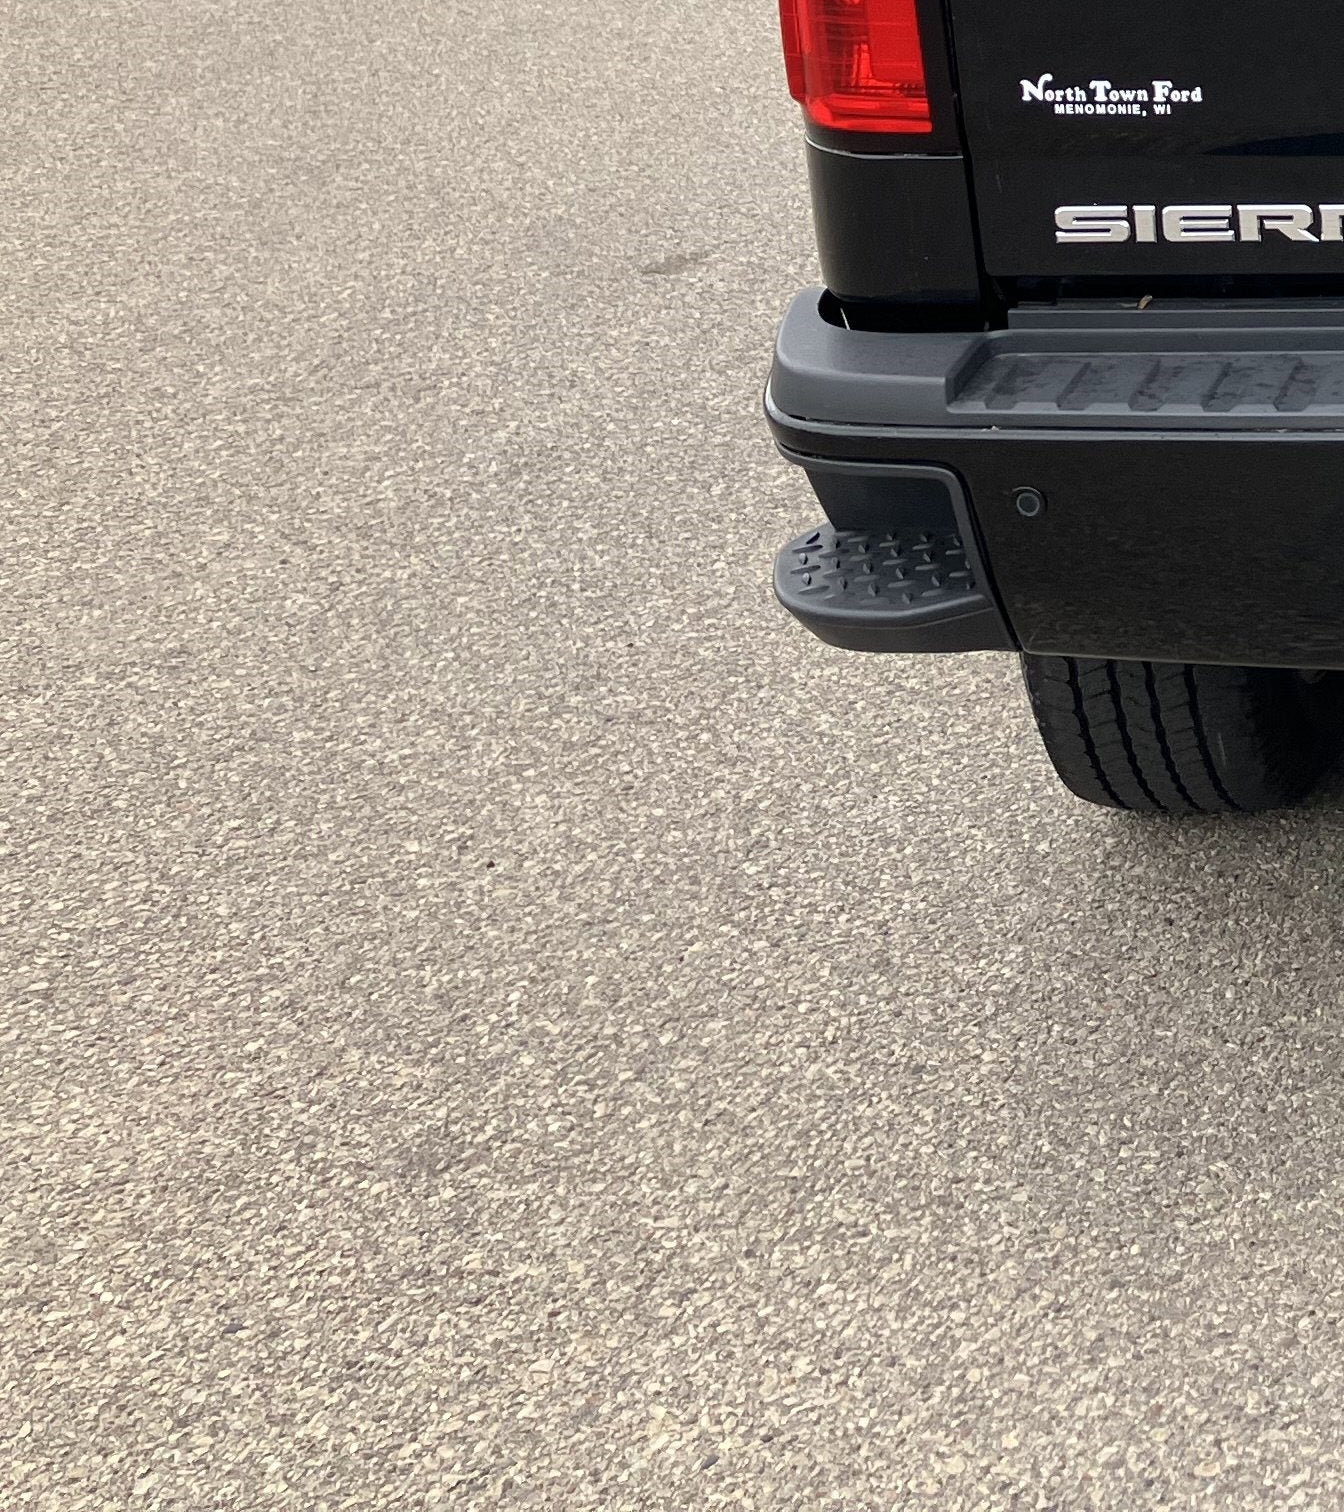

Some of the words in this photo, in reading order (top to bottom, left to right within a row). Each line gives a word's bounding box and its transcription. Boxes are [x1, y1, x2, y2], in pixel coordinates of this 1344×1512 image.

[1019, 73, 1087, 102] North
[1088, 80, 1149, 102] Town
[1151, 80, 1203, 102] Ford
[1053, 103, 1148, 117] MENOMONIE,
[1152, 103, 1172, 115] WI
